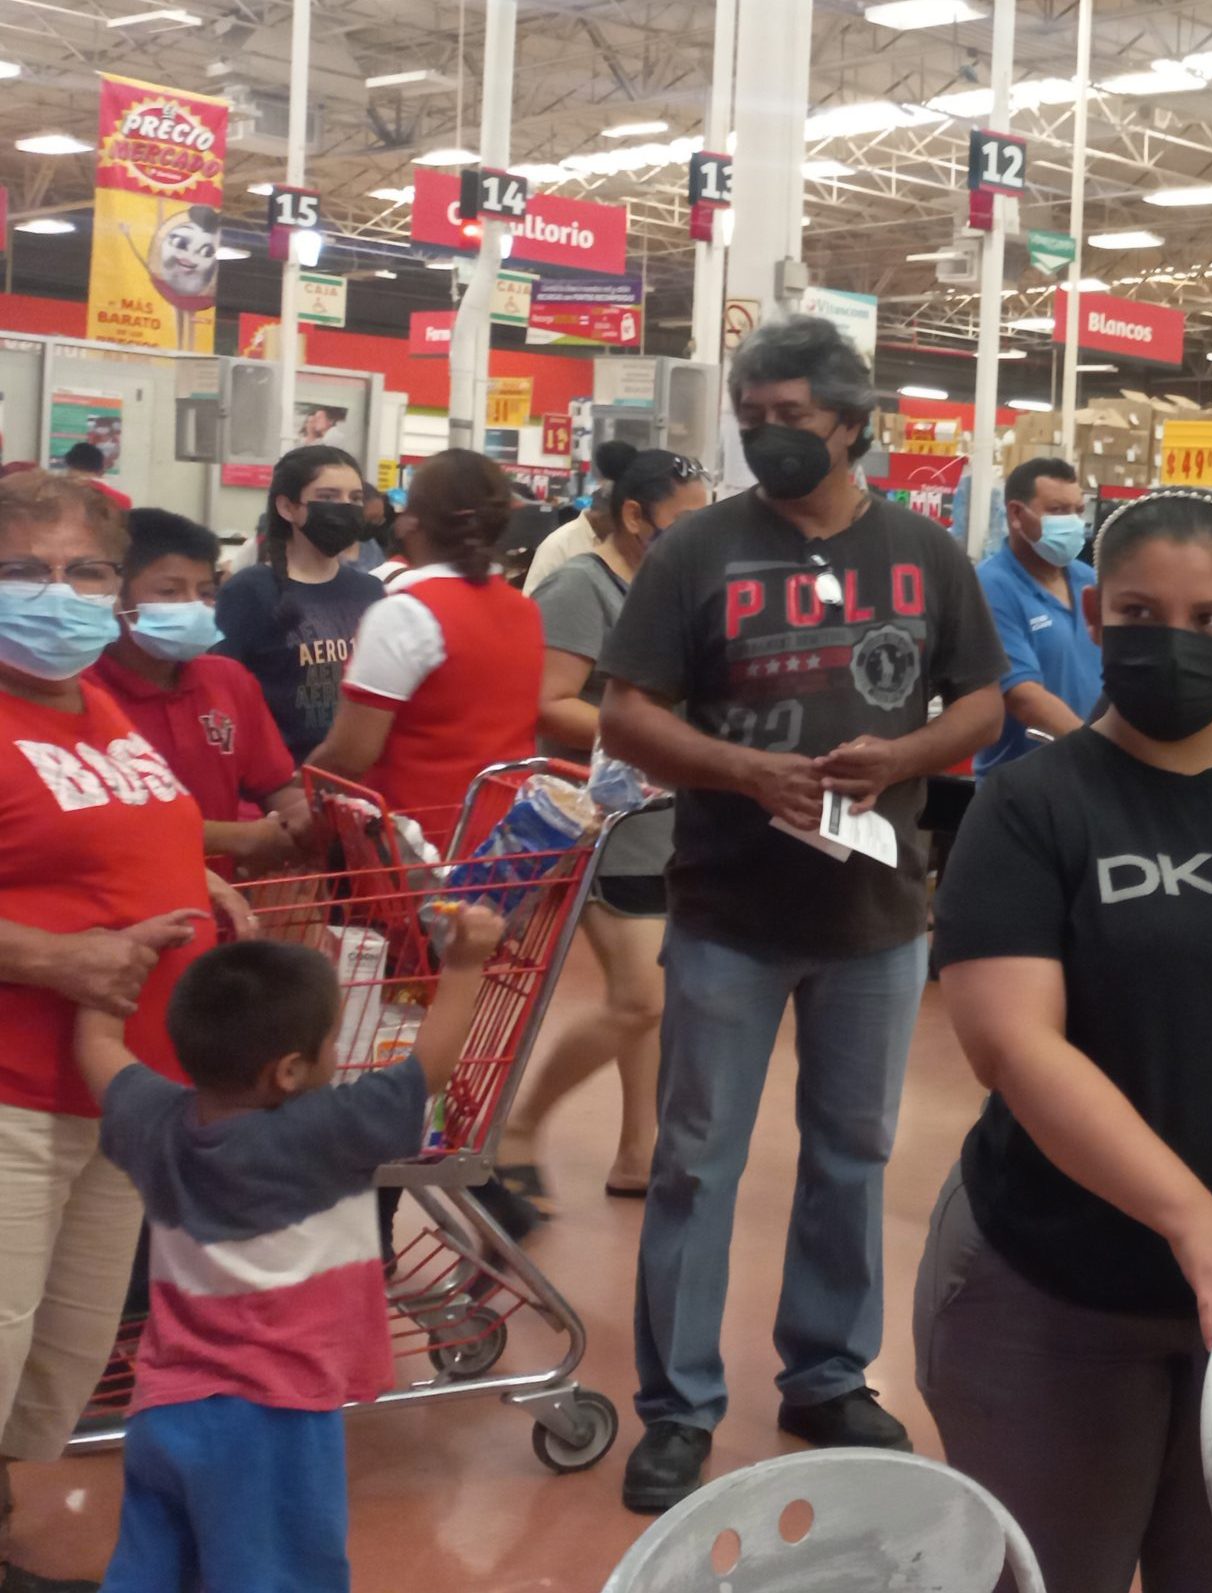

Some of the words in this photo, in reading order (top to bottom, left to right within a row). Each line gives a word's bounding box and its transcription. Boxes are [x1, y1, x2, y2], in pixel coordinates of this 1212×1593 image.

[122, 115, 215, 151] PRECIO
[110, 141, 220, 178] MERCADO
[981, 141, 1024, 187] 12
[276, 193, 318, 227] 15
[482, 177, 526, 215] 14
[304, 283, 338, 297] CAJA
[98, 311, 161, 330] BARATO
[1088, 312, 1152, 342] Blancos
[726, 563, 925, 640] POLO
